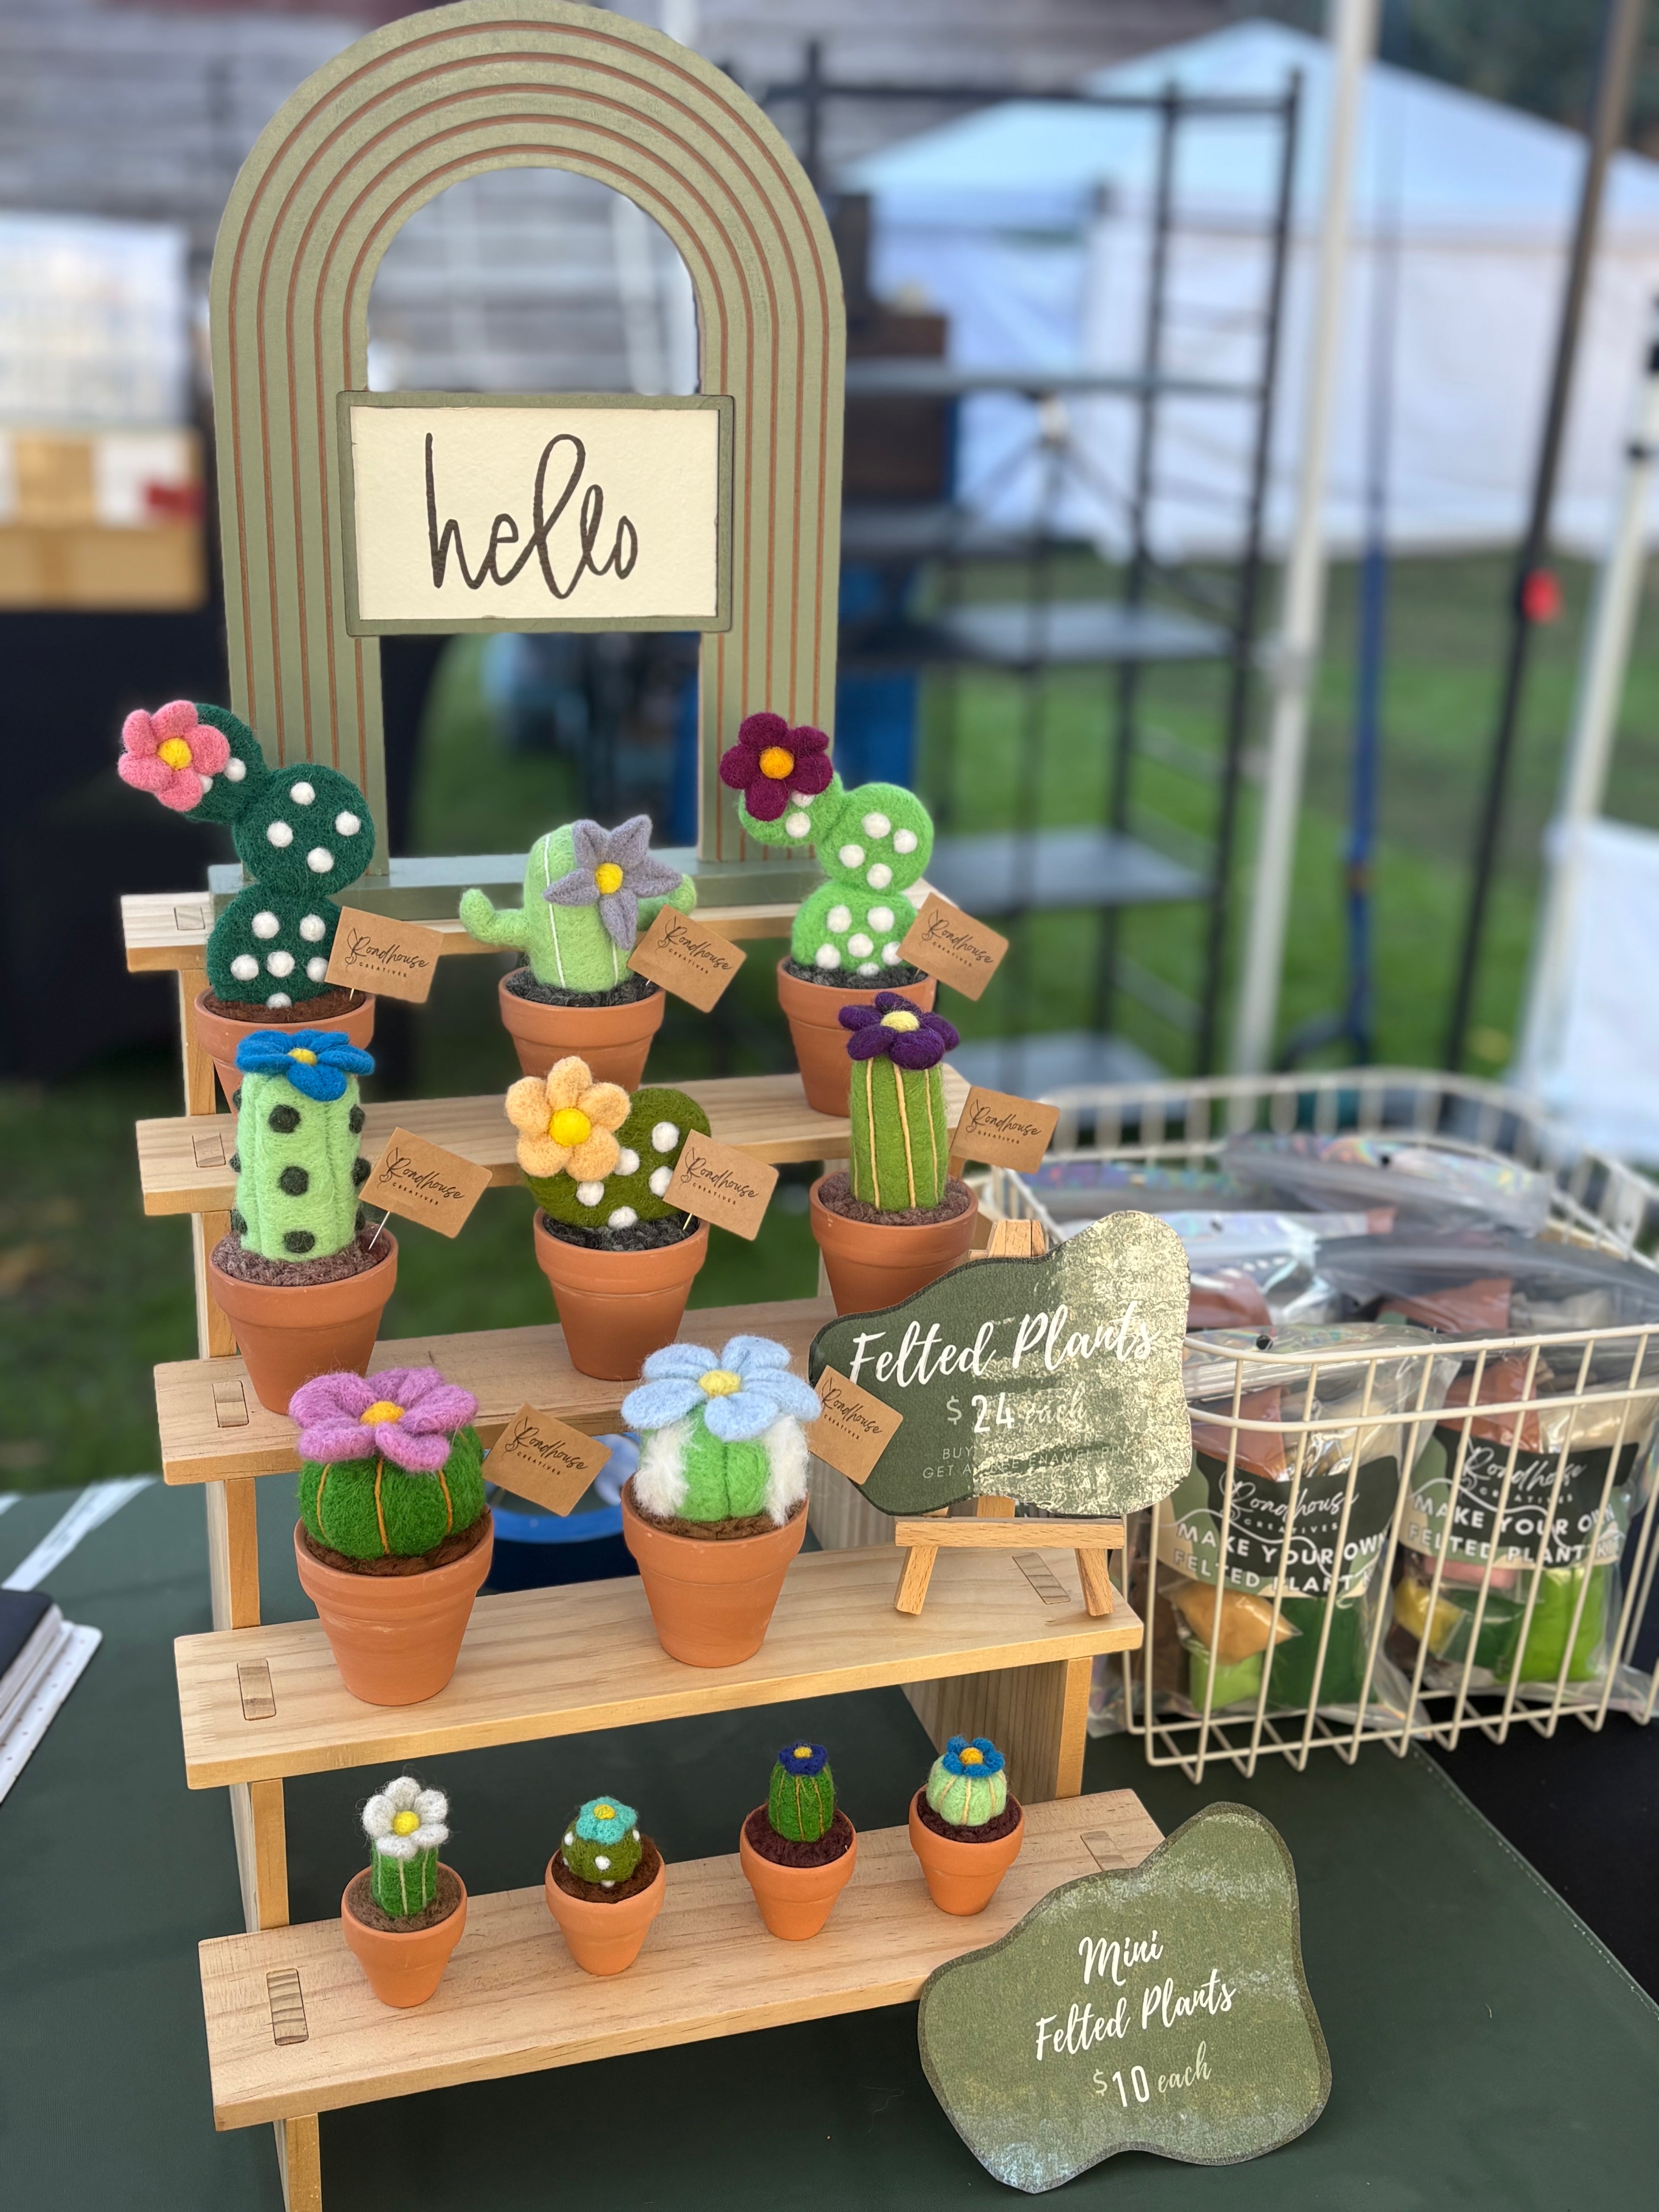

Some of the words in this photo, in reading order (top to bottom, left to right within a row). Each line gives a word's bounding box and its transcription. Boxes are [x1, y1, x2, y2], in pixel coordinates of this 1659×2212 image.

[425, 432, 638, 599] hello
[849, 1320, 996, 1387] Felted
[1012, 1300, 1160, 1371] Plants
[922, 1463, 954, 1478] GET
[962, 1463, 972, 1475] A
[1102, 1445, 1125, 1459] PIN
[942, 1445, 973, 1460] BUY
[1414, 1494, 1485, 1529] MAKE
[1078, 1929, 1163, 1986] Mini
[1036, 1997, 1131, 2061] Felted
[1142, 1968, 1236, 2030] Plants
[1093, 2065, 1150, 2107] $10
[1158, 2040, 1212, 2093] each
